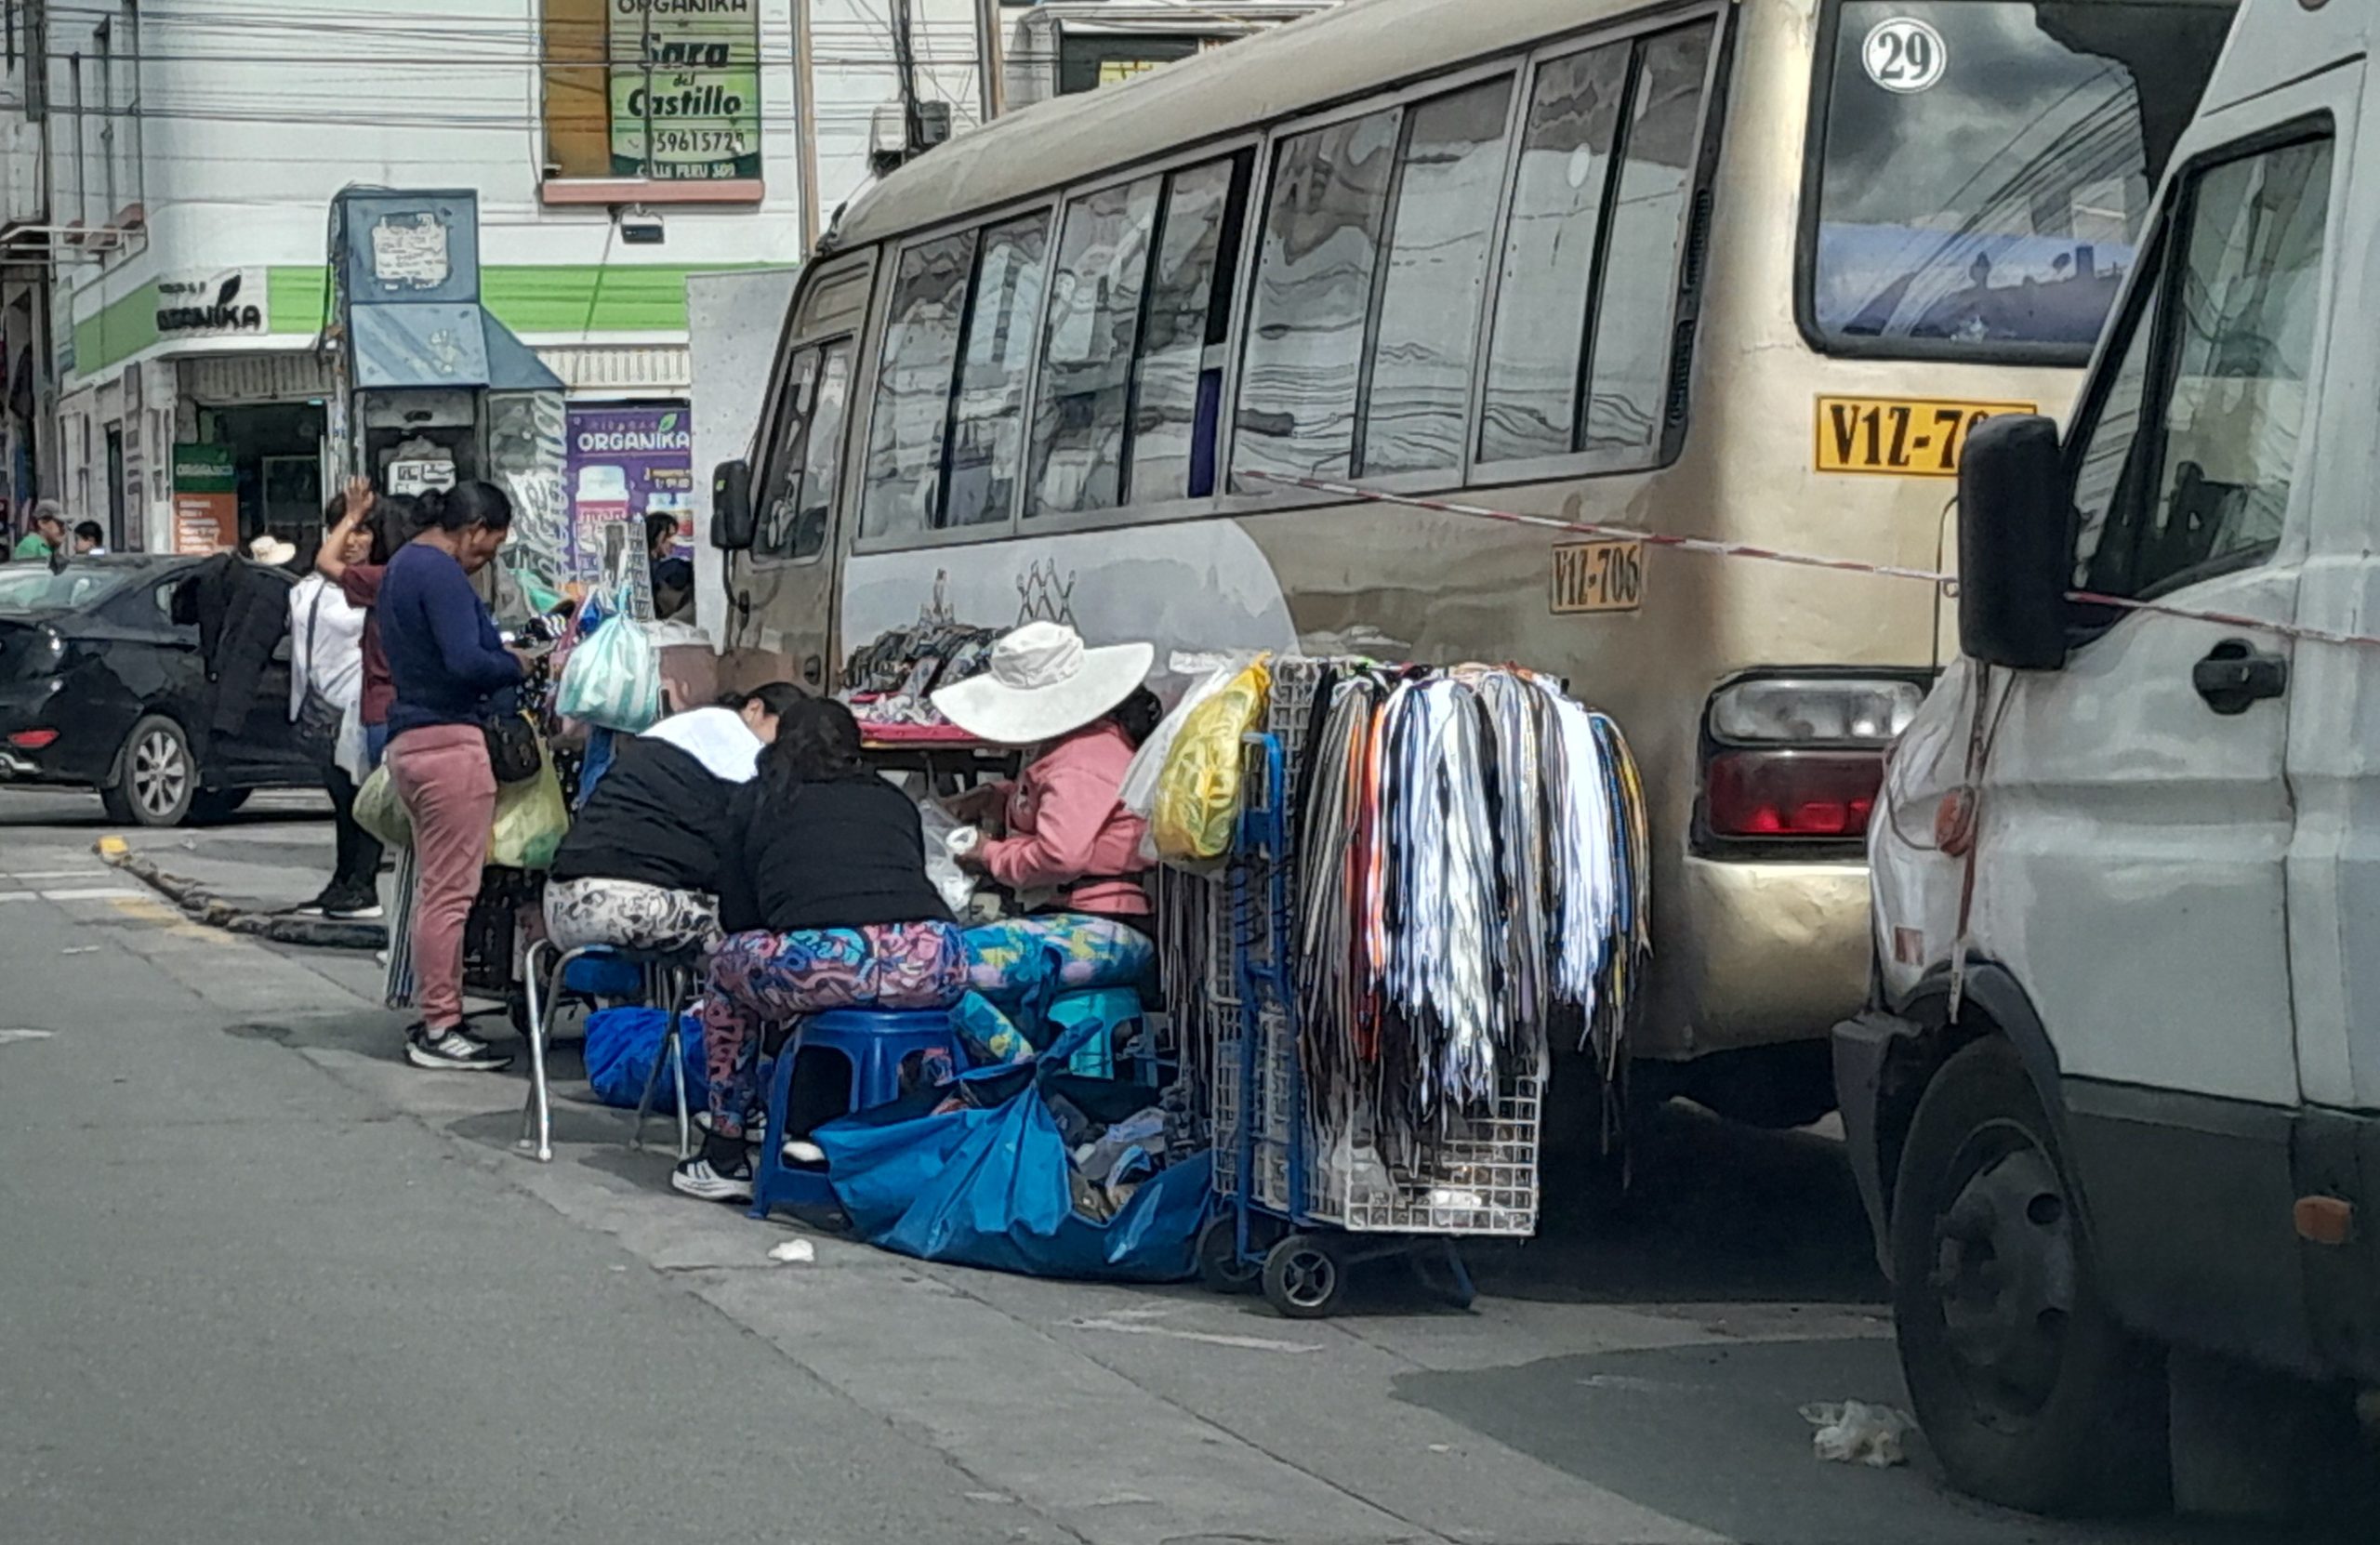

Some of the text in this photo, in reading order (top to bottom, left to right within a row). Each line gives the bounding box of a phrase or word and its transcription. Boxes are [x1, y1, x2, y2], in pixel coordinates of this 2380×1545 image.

[1877, 31, 1932, 81] 29
[672, 72, 696, 86] del
[627, 86, 742, 116] Castillo
[636, 164, 671, 178] CLLE
[576, 430, 690, 452] ORGANIKA
[1829, 404, 1990, 468] V1Z-7
